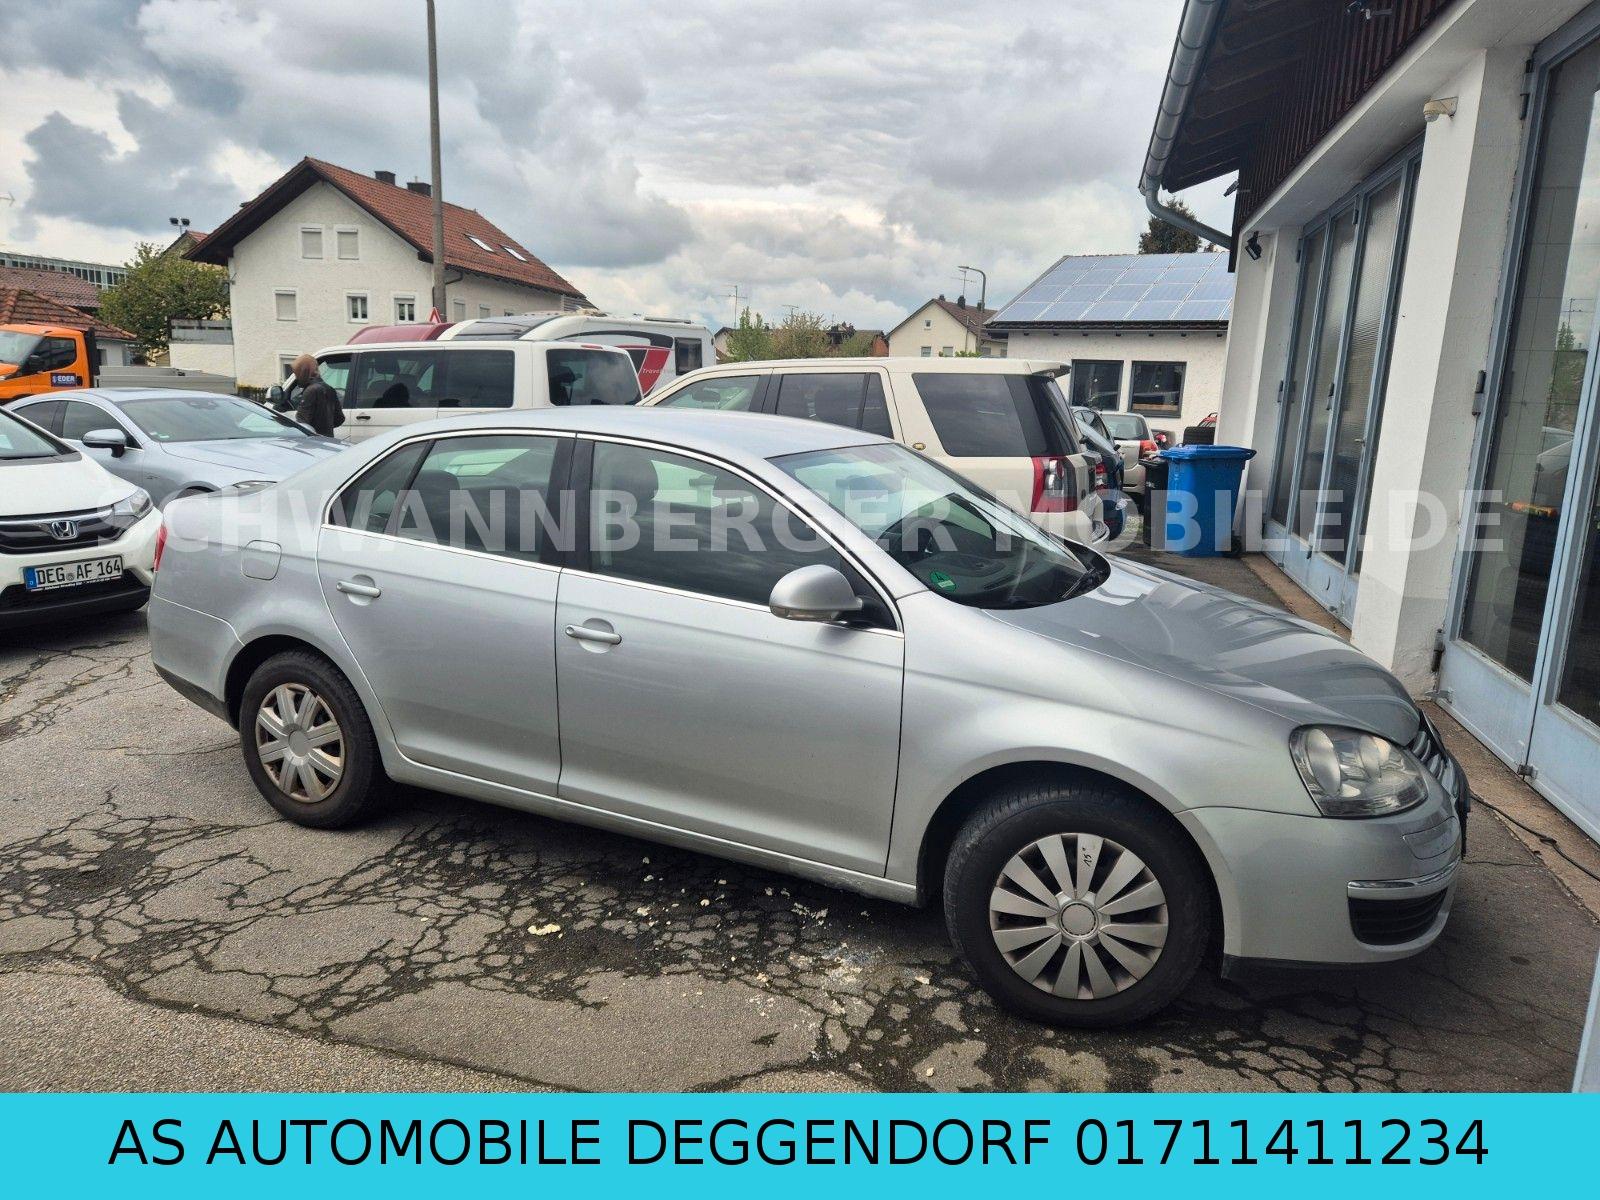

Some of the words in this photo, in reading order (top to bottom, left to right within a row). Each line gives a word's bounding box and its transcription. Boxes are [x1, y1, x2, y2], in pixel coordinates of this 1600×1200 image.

[35, 567, 65, 585] DEG
[76, 563, 93, 579] AF
[96, 559, 121, 576] 164
